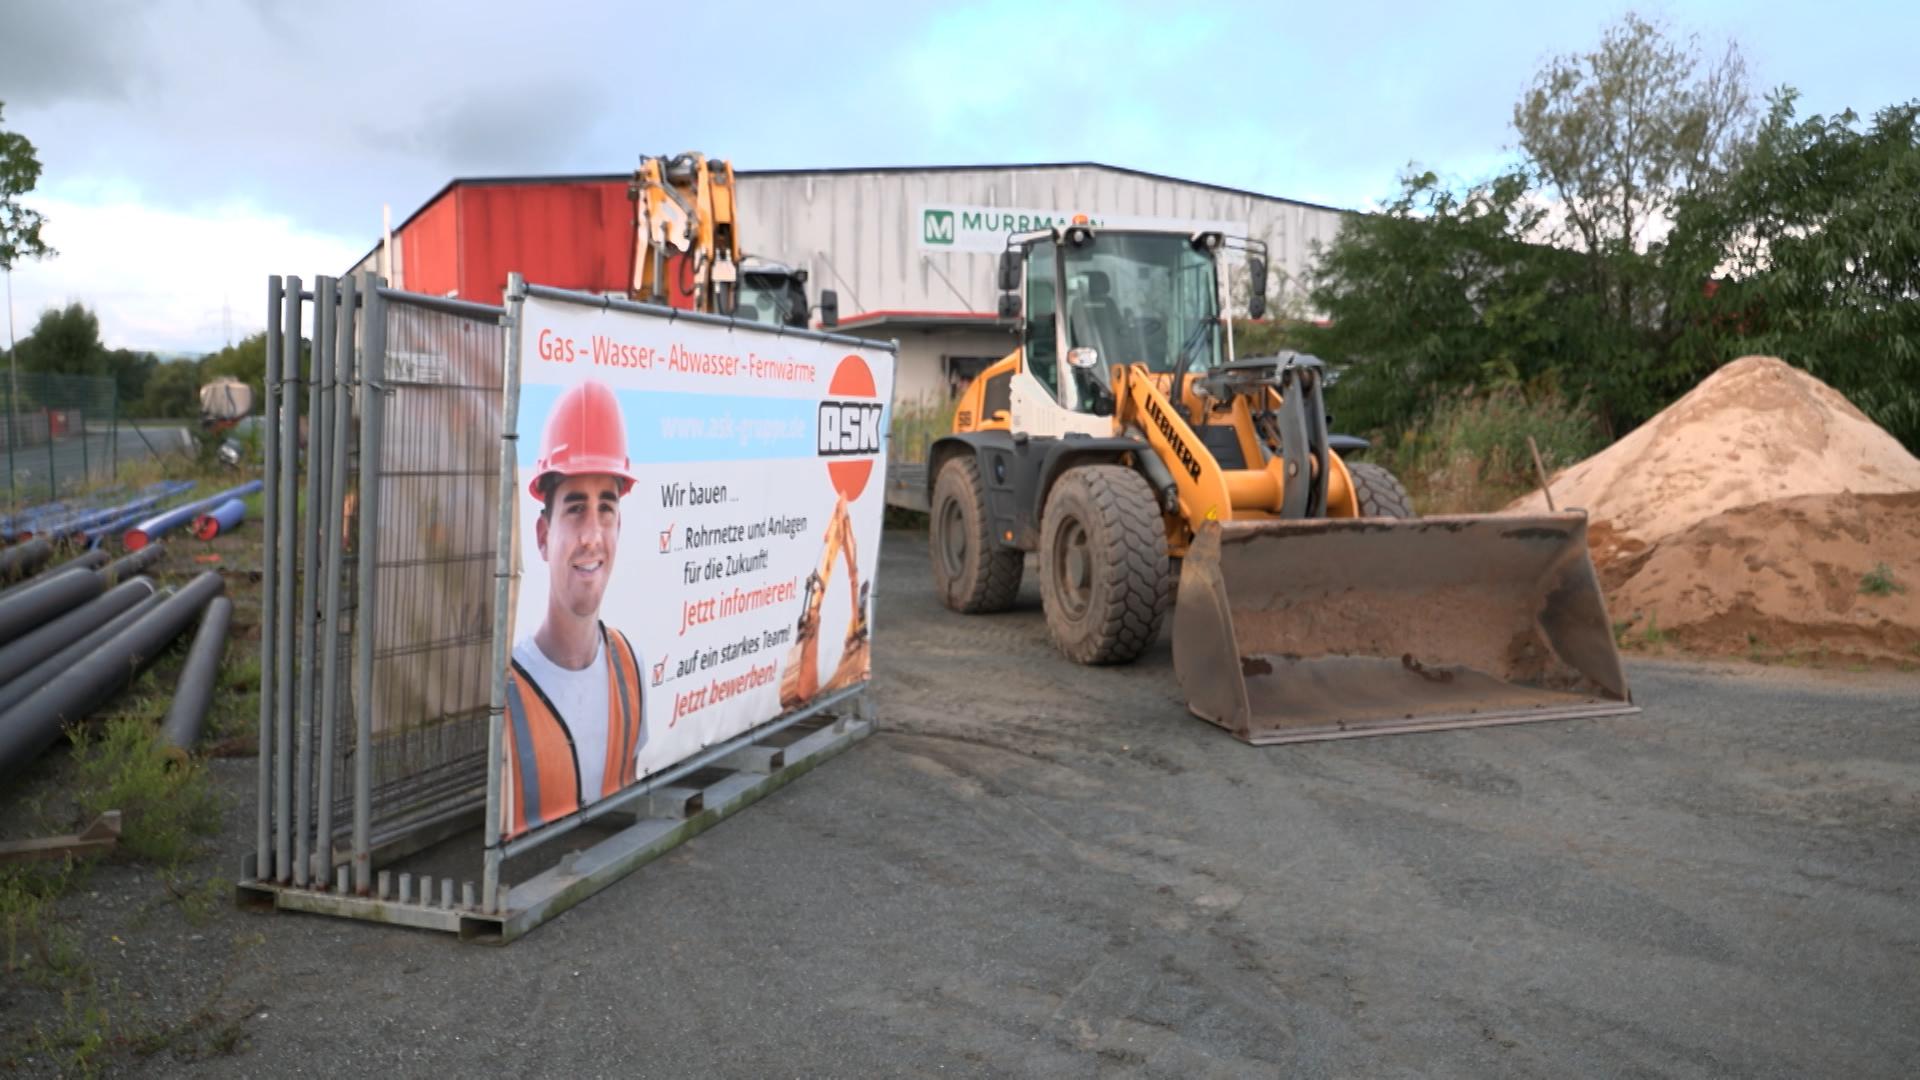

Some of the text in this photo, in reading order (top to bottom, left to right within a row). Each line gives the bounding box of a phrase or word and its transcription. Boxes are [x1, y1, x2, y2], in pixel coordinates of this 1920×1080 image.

[962, 211, 1104, 232] MURRM
[538, 328, 575, 363] Gas
[592, 335, 655, 369] Wasser
[668, 344, 739, 376] Abwasser
[749, 353, 816, 383] Fernwärme
[818, 401, 883, 456] ASK
[1145, 393, 1202, 486] LIEBHERR
[661, 482, 686, 508] Wir
[689, 482, 727, 506] bauen
[685, 523, 745, 550] Rohrnetze
[747, 521, 766, 540] und
[767, 515, 808, 540] Anlagen
[684, 561, 701, 585] für
[704, 558, 723, 581] die
[678, 576, 797, 637] Jetzt informieren!
[700, 646, 718, 670] ein
[720, 636, 760, 664] starkes
[763, 624, 792, 648] Team!
[669, 658, 777, 728] Jetzt bewerben!
